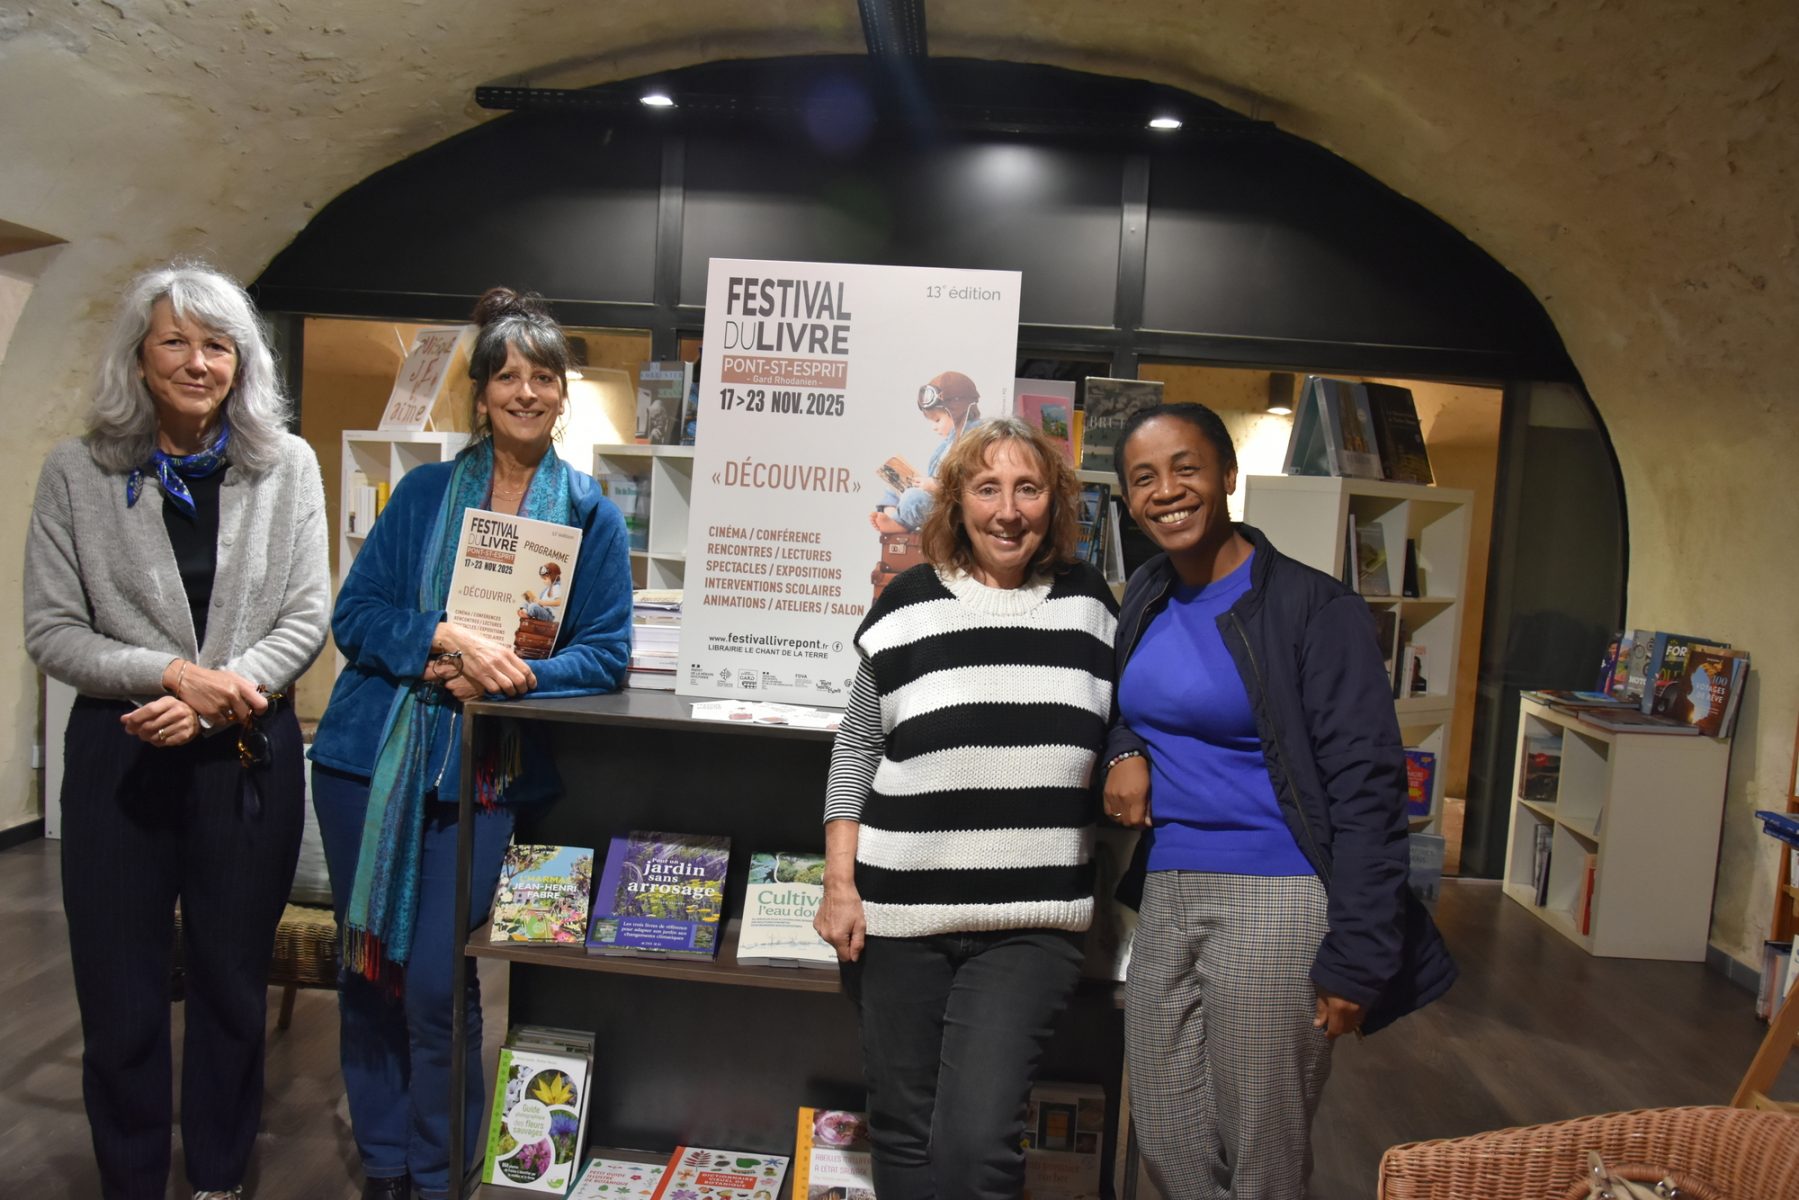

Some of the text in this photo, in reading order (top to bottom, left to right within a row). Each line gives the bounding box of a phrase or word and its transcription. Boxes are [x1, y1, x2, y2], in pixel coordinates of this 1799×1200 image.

[727, 277, 852, 320] FESTIVAL
[949, 286, 1001, 301] édition
[724, 359, 846, 378] PONT-ST-ESPRIT
[753, 376, 773, 384] Gard
[774, 376, 817, 386] Rhodanien
[771, 390, 803, 414] NOV.
[806, 393, 845, 417] 2025
[471, 517, 519, 539] FESTIVAL
[709, 525, 747, 540] CINÉMA
[756, 528, 821, 544] CONFÉRENCE
[524, 541, 570, 563] PROGRAMME
[707, 543, 772, 559] RENCONTRES
[782, 547, 832, 562] LECTURES
[497, 563, 513, 575] 2025
[706, 560, 767, 576] SPECTACLES
[776, 565, 842, 580] EXPOSITIONS
[705, 577, 841, 597] INTERVENTIONS SCOLAIRES
[703, 594, 766, 610] ANIMATIONS
[775, 599, 822, 613] ATELIERS
[831, 603, 865, 617] SALON
[709, 633, 829, 651] www.festivallivrepont.fr
[708, 645, 743, 653] LIBRAIRIE
[755, 647, 780, 655] CHANT
[805, 651, 828, 659] TERRE
[643, 860, 705, 876] jardin
[512, 883, 577, 892] JEAN-HENRI
[648, 874, 679, 882] sans
[527, 891, 561, 899] FABRE
[627, 881, 716, 900] arrosage
[758, 905, 790, 916] l'eau
